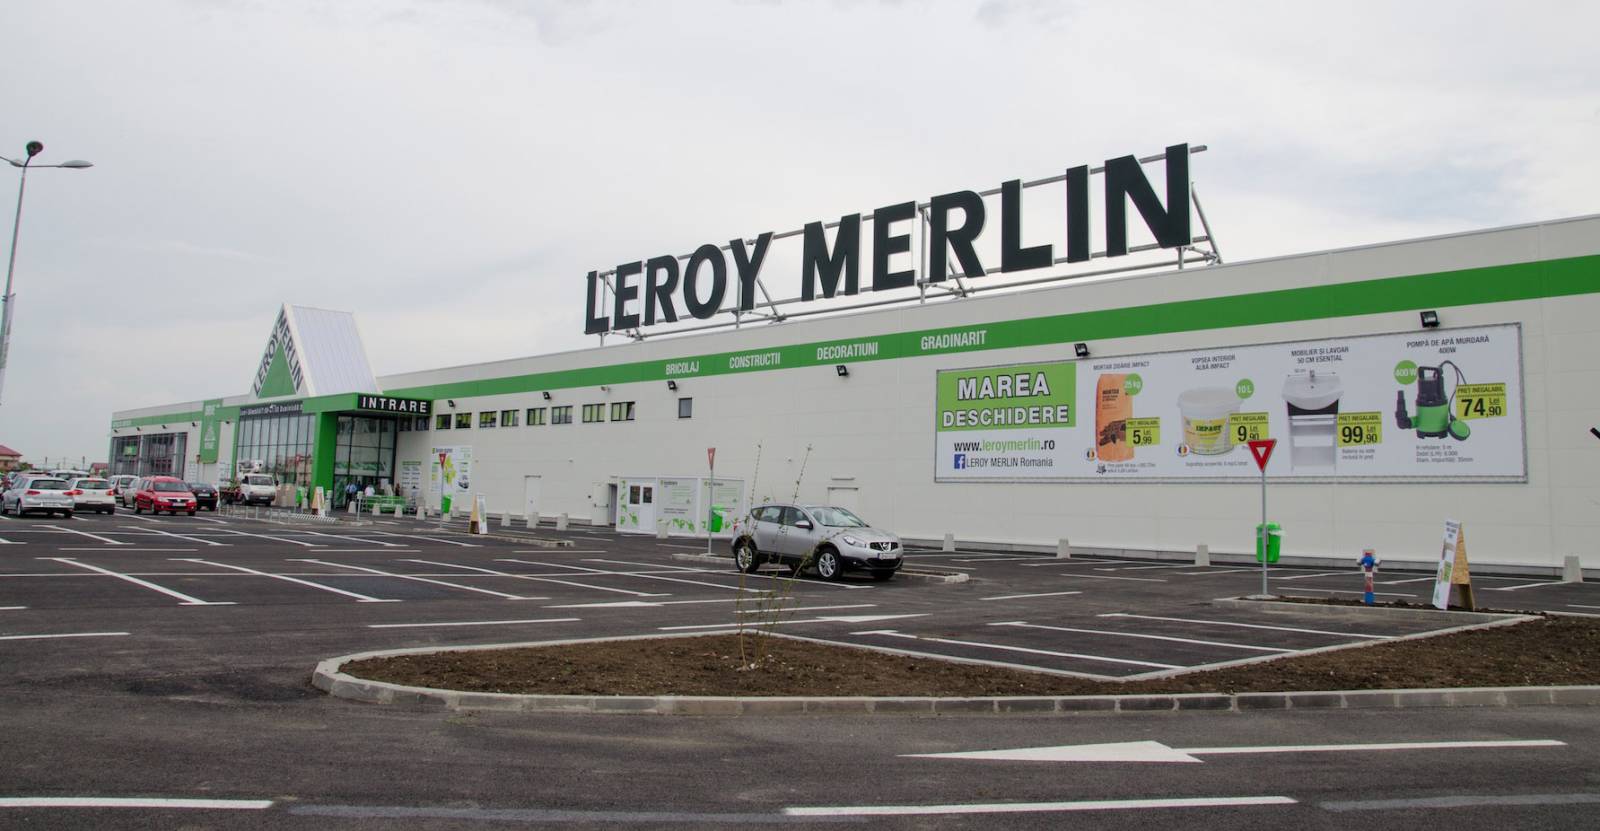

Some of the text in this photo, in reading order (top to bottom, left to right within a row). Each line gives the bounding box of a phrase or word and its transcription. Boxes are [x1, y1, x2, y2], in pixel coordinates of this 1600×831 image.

[585, 142, 1191, 336] LEROY MERLIN
[921, 330, 987, 350] GRADINARIT
[278, 310, 303, 392] MERLIN
[817, 342, 878, 361] DECORATIUNI
[1212, 354, 1235, 362] INTERIOR
[1291, 349, 1318, 357] MOBILIER
[254, 326, 279, 396] LEROY
[665, 361, 699, 376] BRICOLAJ
[729, 352, 780, 369] CONSTRUCTII
[957, 372, 1050, 401] MAREA
[362, 396, 427, 413] INTRARE
[942, 405, 1069, 428] DESCHIDERE
[954, 438, 1055, 453] www.leroymerlin.ro
[967, 458, 989, 468] LEROY
[991, 457, 1018, 468] MERLIN
[1020, 457, 1053, 468] Romania
